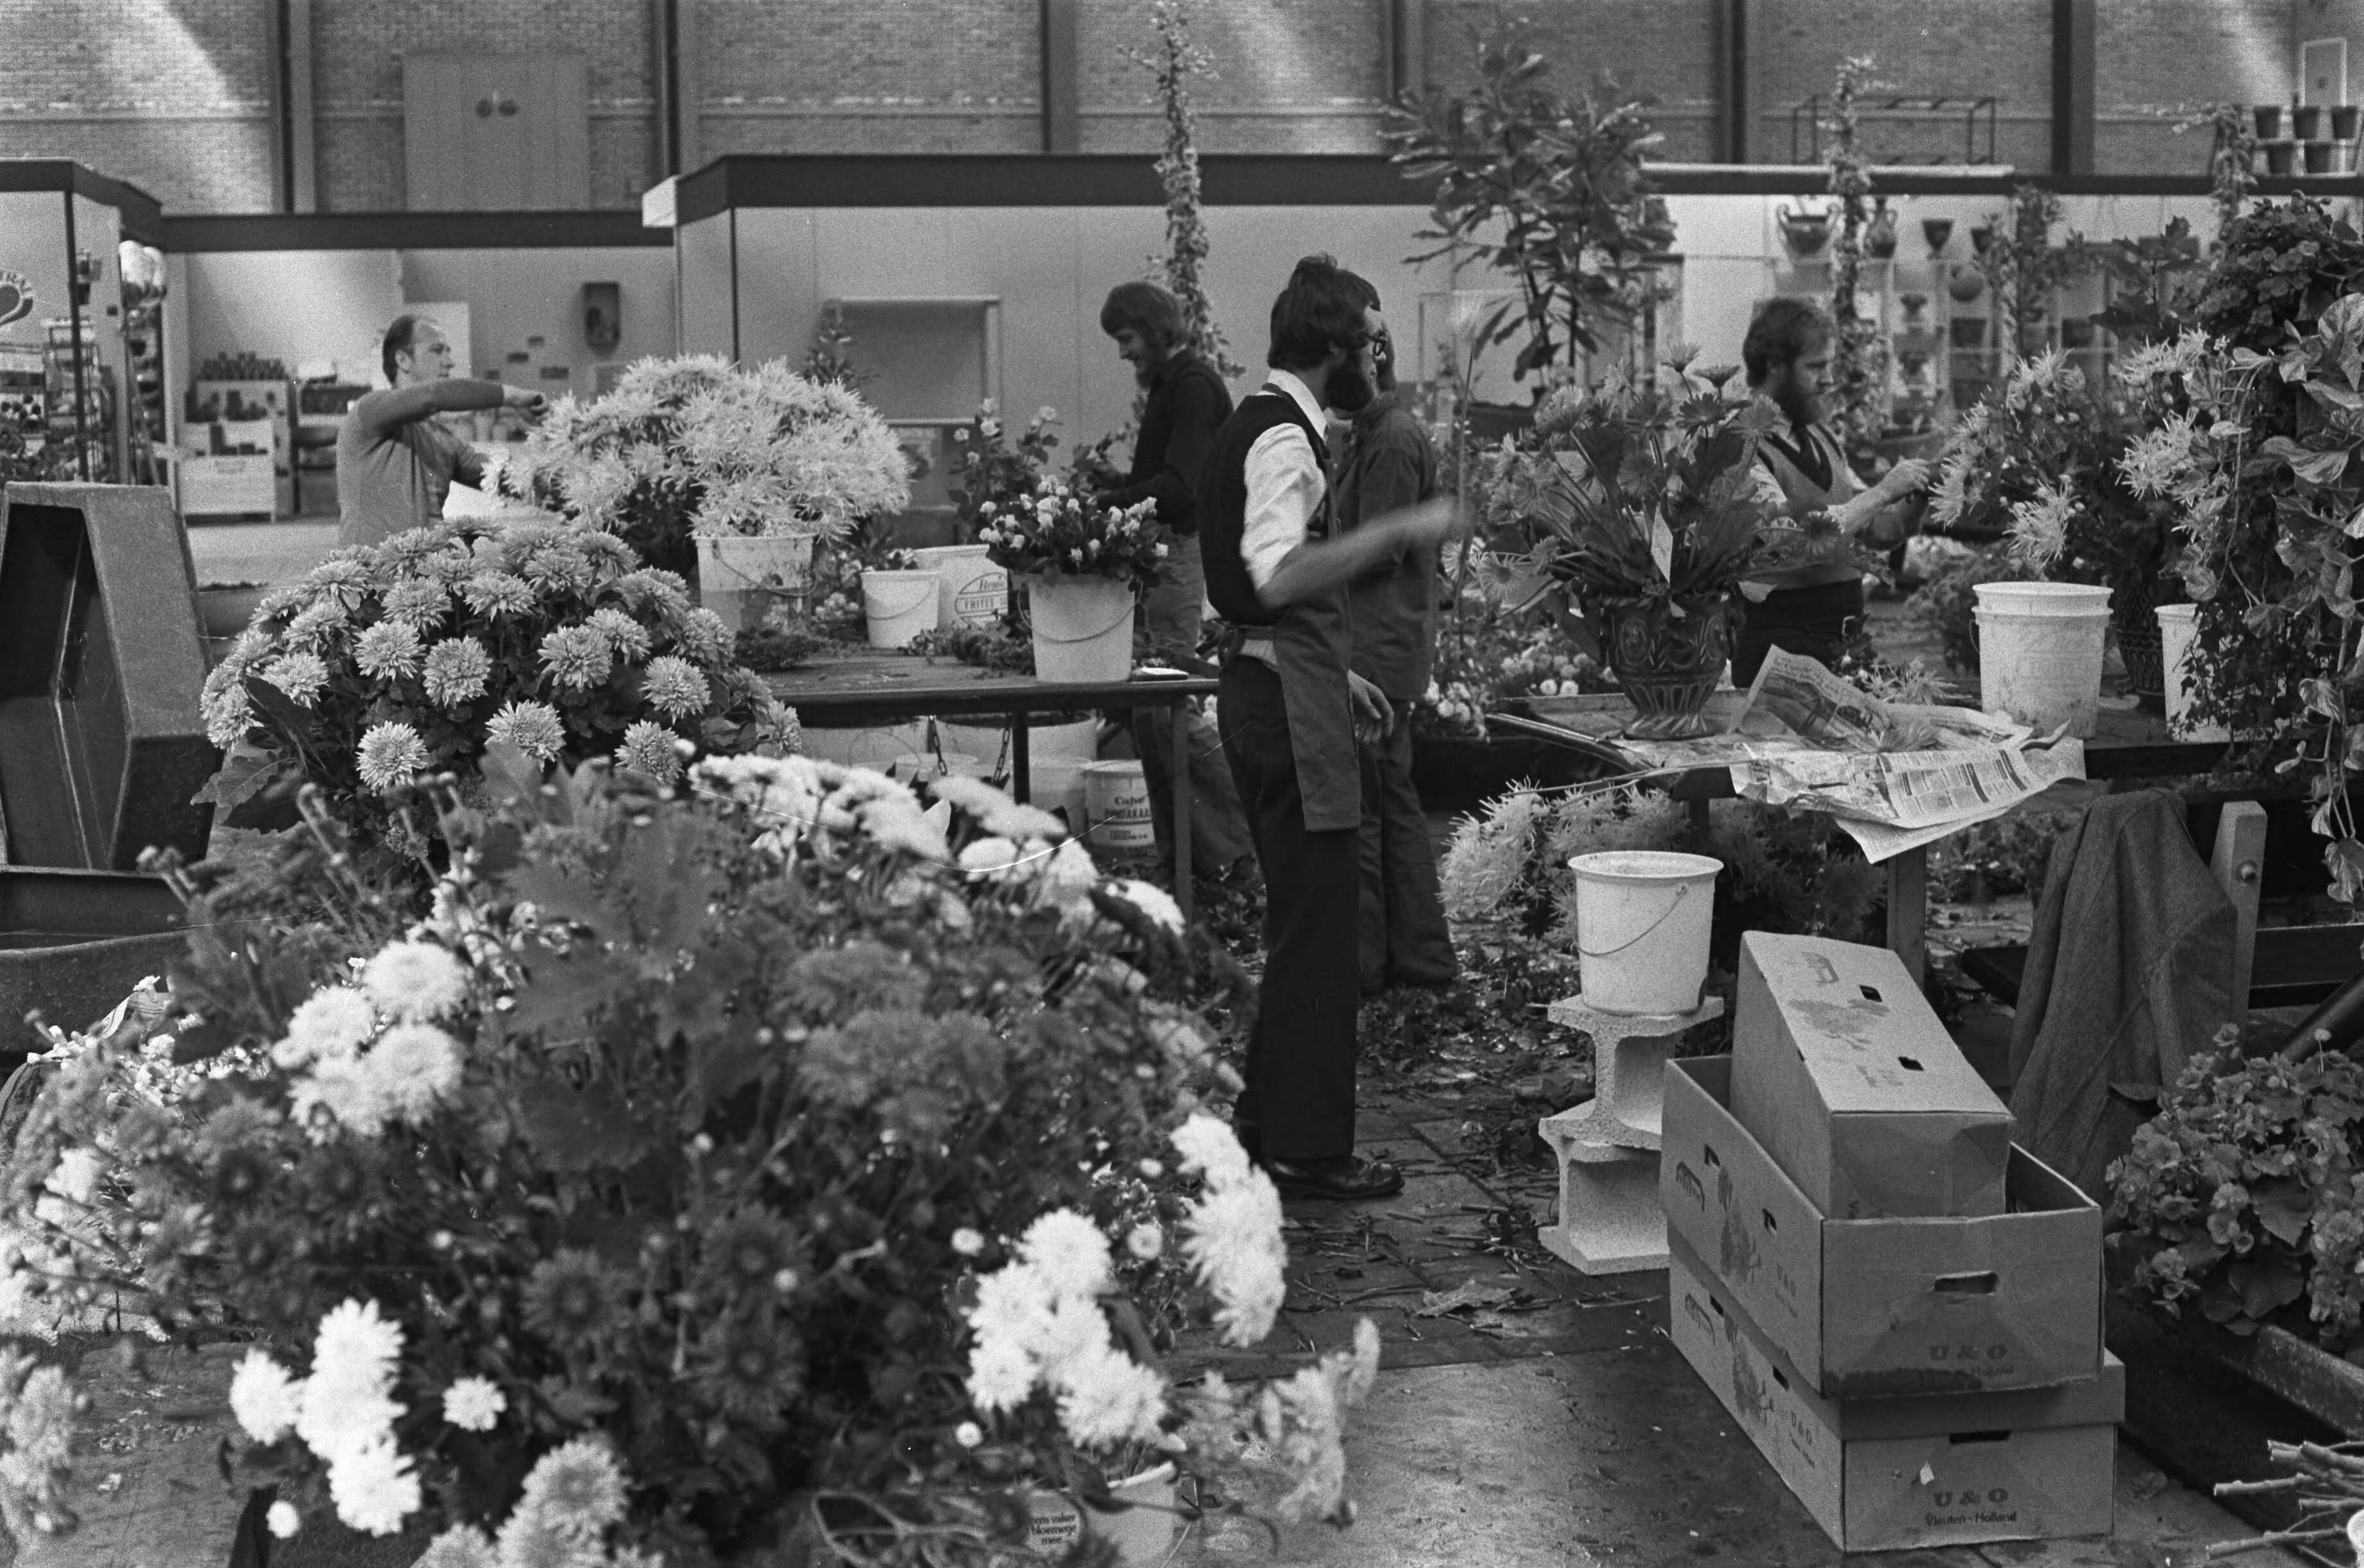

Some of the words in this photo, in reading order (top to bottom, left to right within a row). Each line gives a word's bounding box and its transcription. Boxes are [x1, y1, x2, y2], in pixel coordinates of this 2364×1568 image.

[1928, 1344, 1950, 1361] U
[1986, 1344, 2007, 1360] O
[1933, 1492, 1954, 1508] U
[1959, 1490, 1981, 1506] &
[1988, 1488, 2009, 1504] O
[1051, 1511, 1075, 1523] vaker
[1975, 1511, 2017, 1523] Holland
[1041, 1537, 1063, 1546] mee
